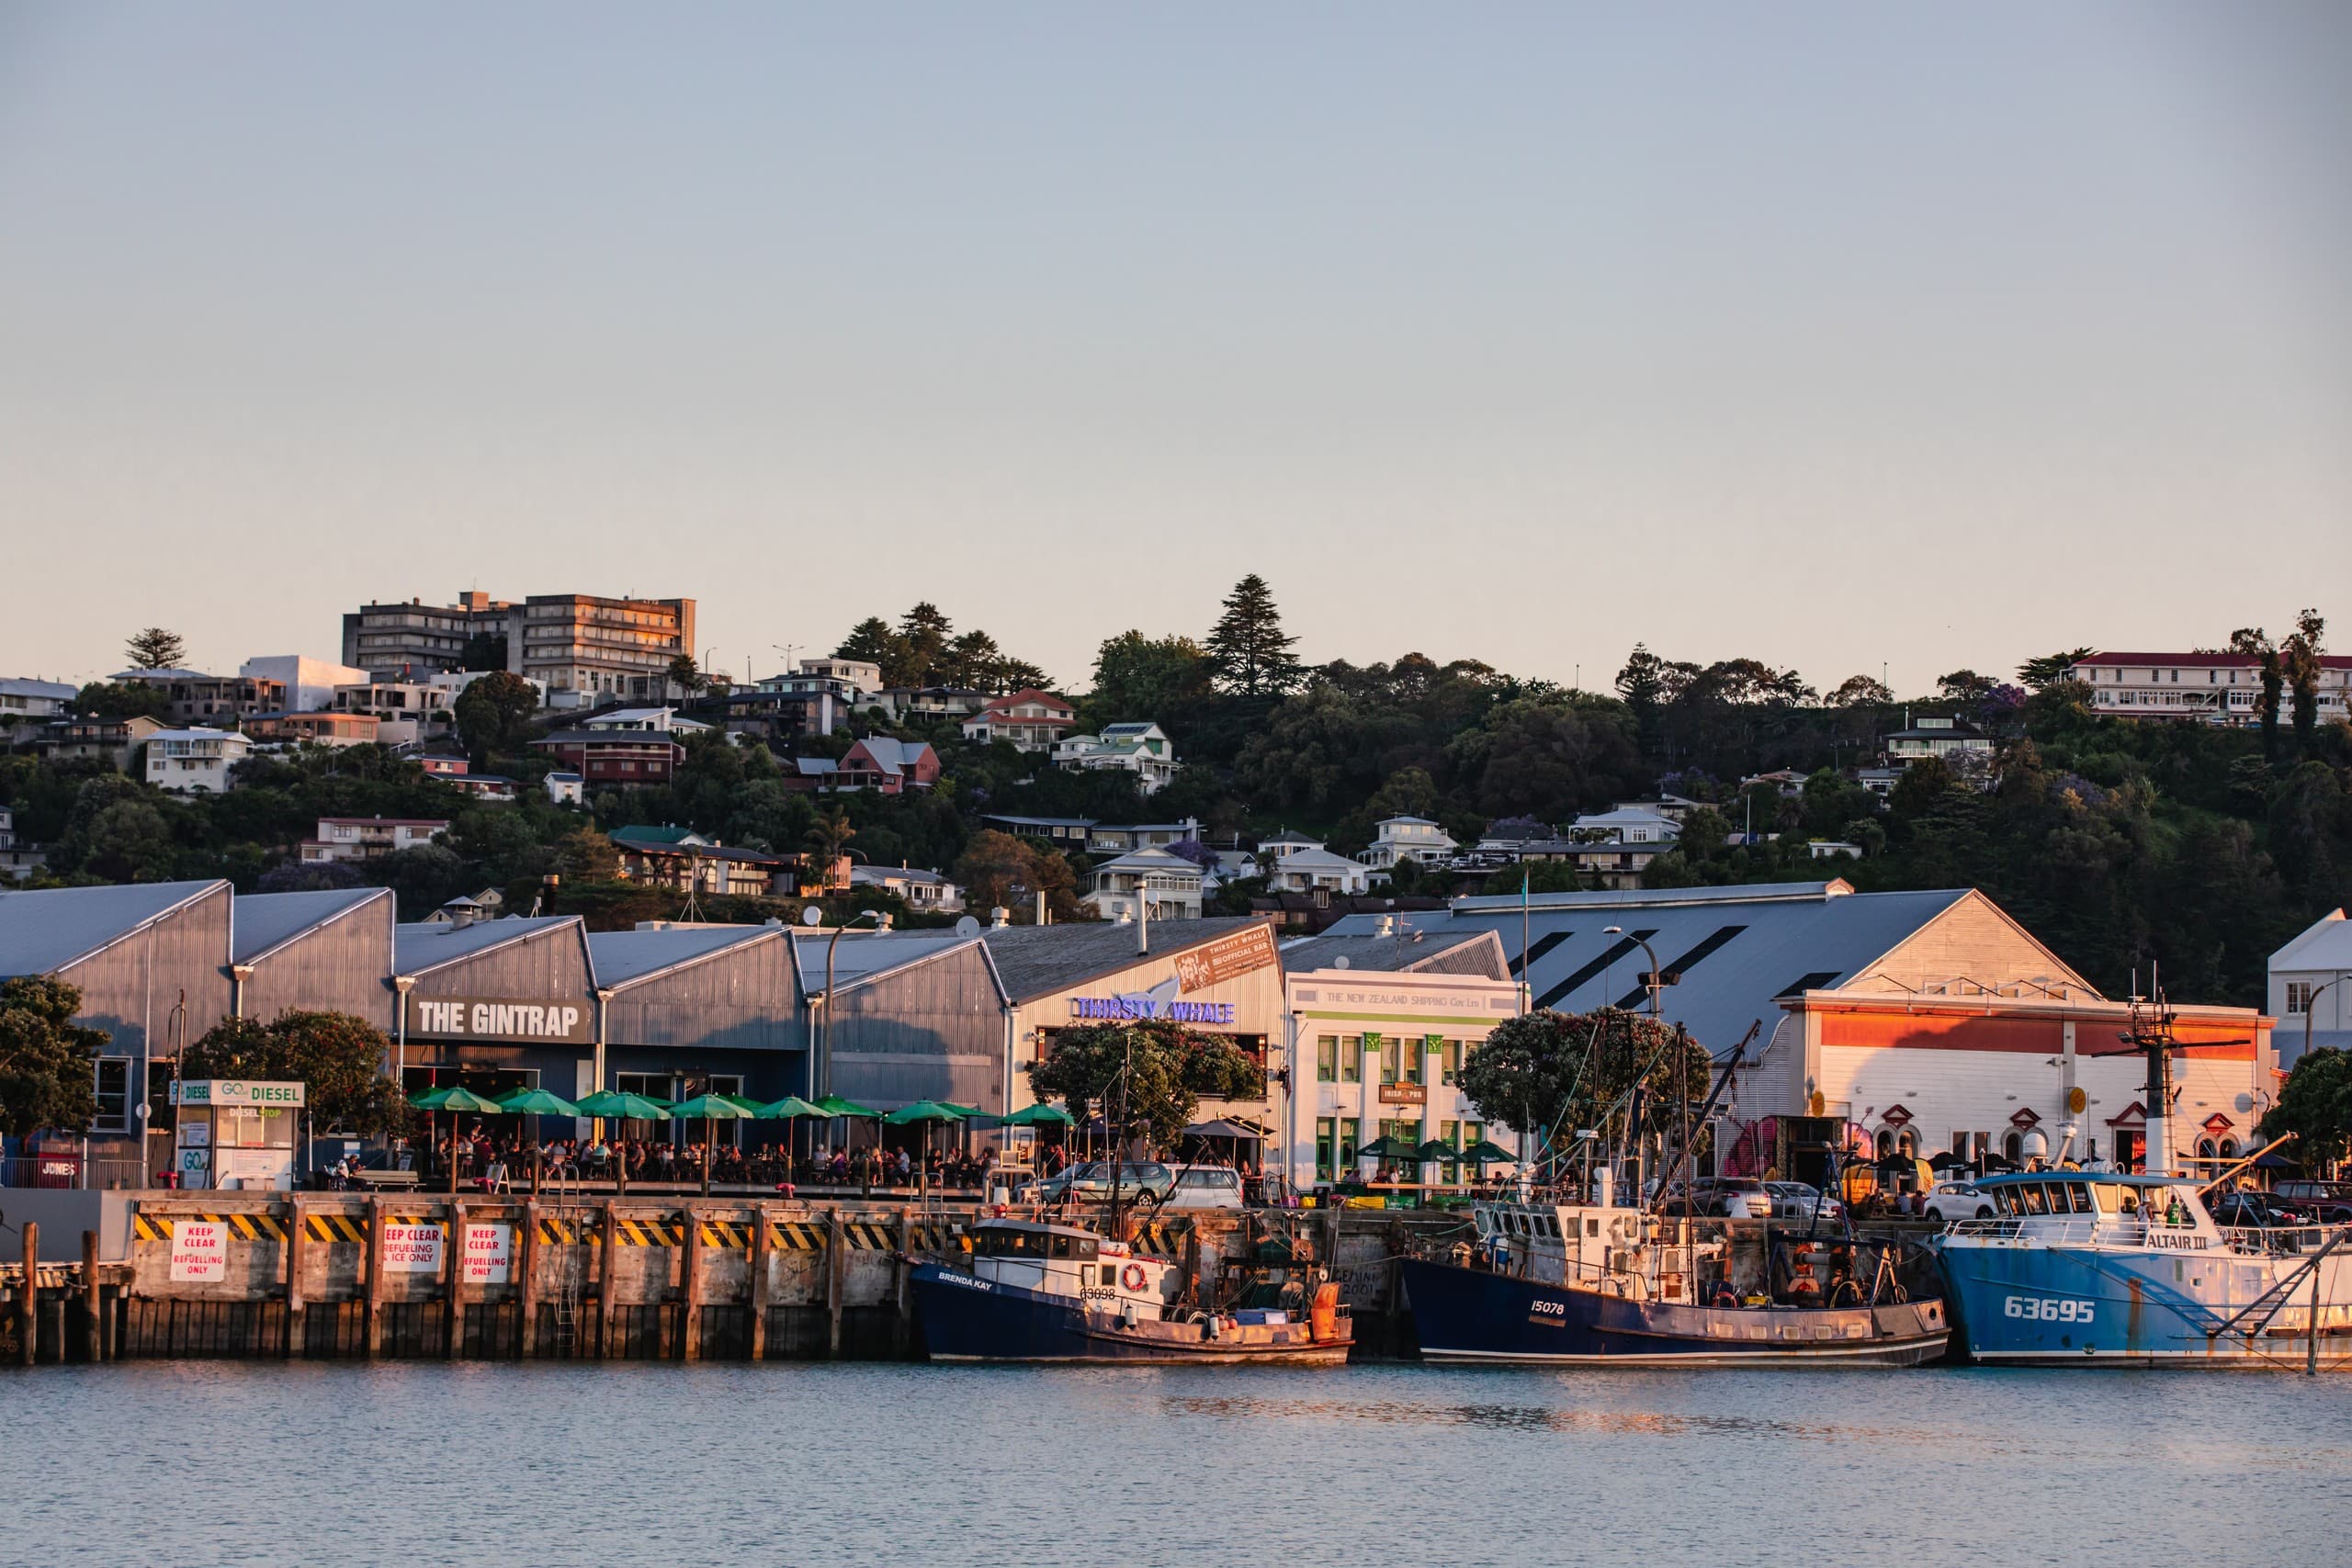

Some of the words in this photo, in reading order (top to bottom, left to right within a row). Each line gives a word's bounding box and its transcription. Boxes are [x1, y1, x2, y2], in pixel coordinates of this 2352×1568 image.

[1210, 940, 1238, 954] THIRSTY
[1241, 931, 1265, 944] WHALE
[1222, 947, 1251, 963] OFFICIAL
[1253, 942, 1269, 953] BAR
[1327, 992, 1344, 1003] THE
[1347, 993, 1364, 1003] NEW
[1369, 994, 1408, 1005] ZEALAND
[1411, 996, 1447, 1007] SHIPPING
[1078, 998, 1159, 1021] THIRSTY
[1170, 1000, 1236, 1023] WHALE
[419, 1001, 465, 1033] THE
[471, 1003, 579, 1037] GINTRAP
[186, 1086, 210, 1100] DIESEL
[252, 1087, 300, 1101] DIESEL
[42, 1161, 75, 1176] JONES
[187, 1227, 213, 1236] KEEP
[386, 1229, 404, 1240] EEP
[407, 1229, 439, 1241] CLEAR
[471, 1229, 497, 1239] KEEP
[184, 1238, 216, 1247] CLEAR
[469, 1240, 499, 1250] CLEAR
[2147, 1234, 2191, 1249] ALTAIR
[2193, 1235, 2208, 1249] III
[174, 1255, 223, 1264] REFUELLING
[392, 1253, 405, 1262] ICE
[409, 1253, 434, 1263] ONLY
[464, 1257, 506, 1266] EFUELLING
[187, 1266, 208, 1274] ONLY
[471, 1267, 492, 1276] ONLY
[938, 1271, 974, 1287] BRENDA
[974, 1279, 992, 1292] KAY
[1343, 1284, 1374, 1294] 2001
[1531, 1300, 1565, 1314] 15078
[2005, 1295, 2096, 1324] 63695
